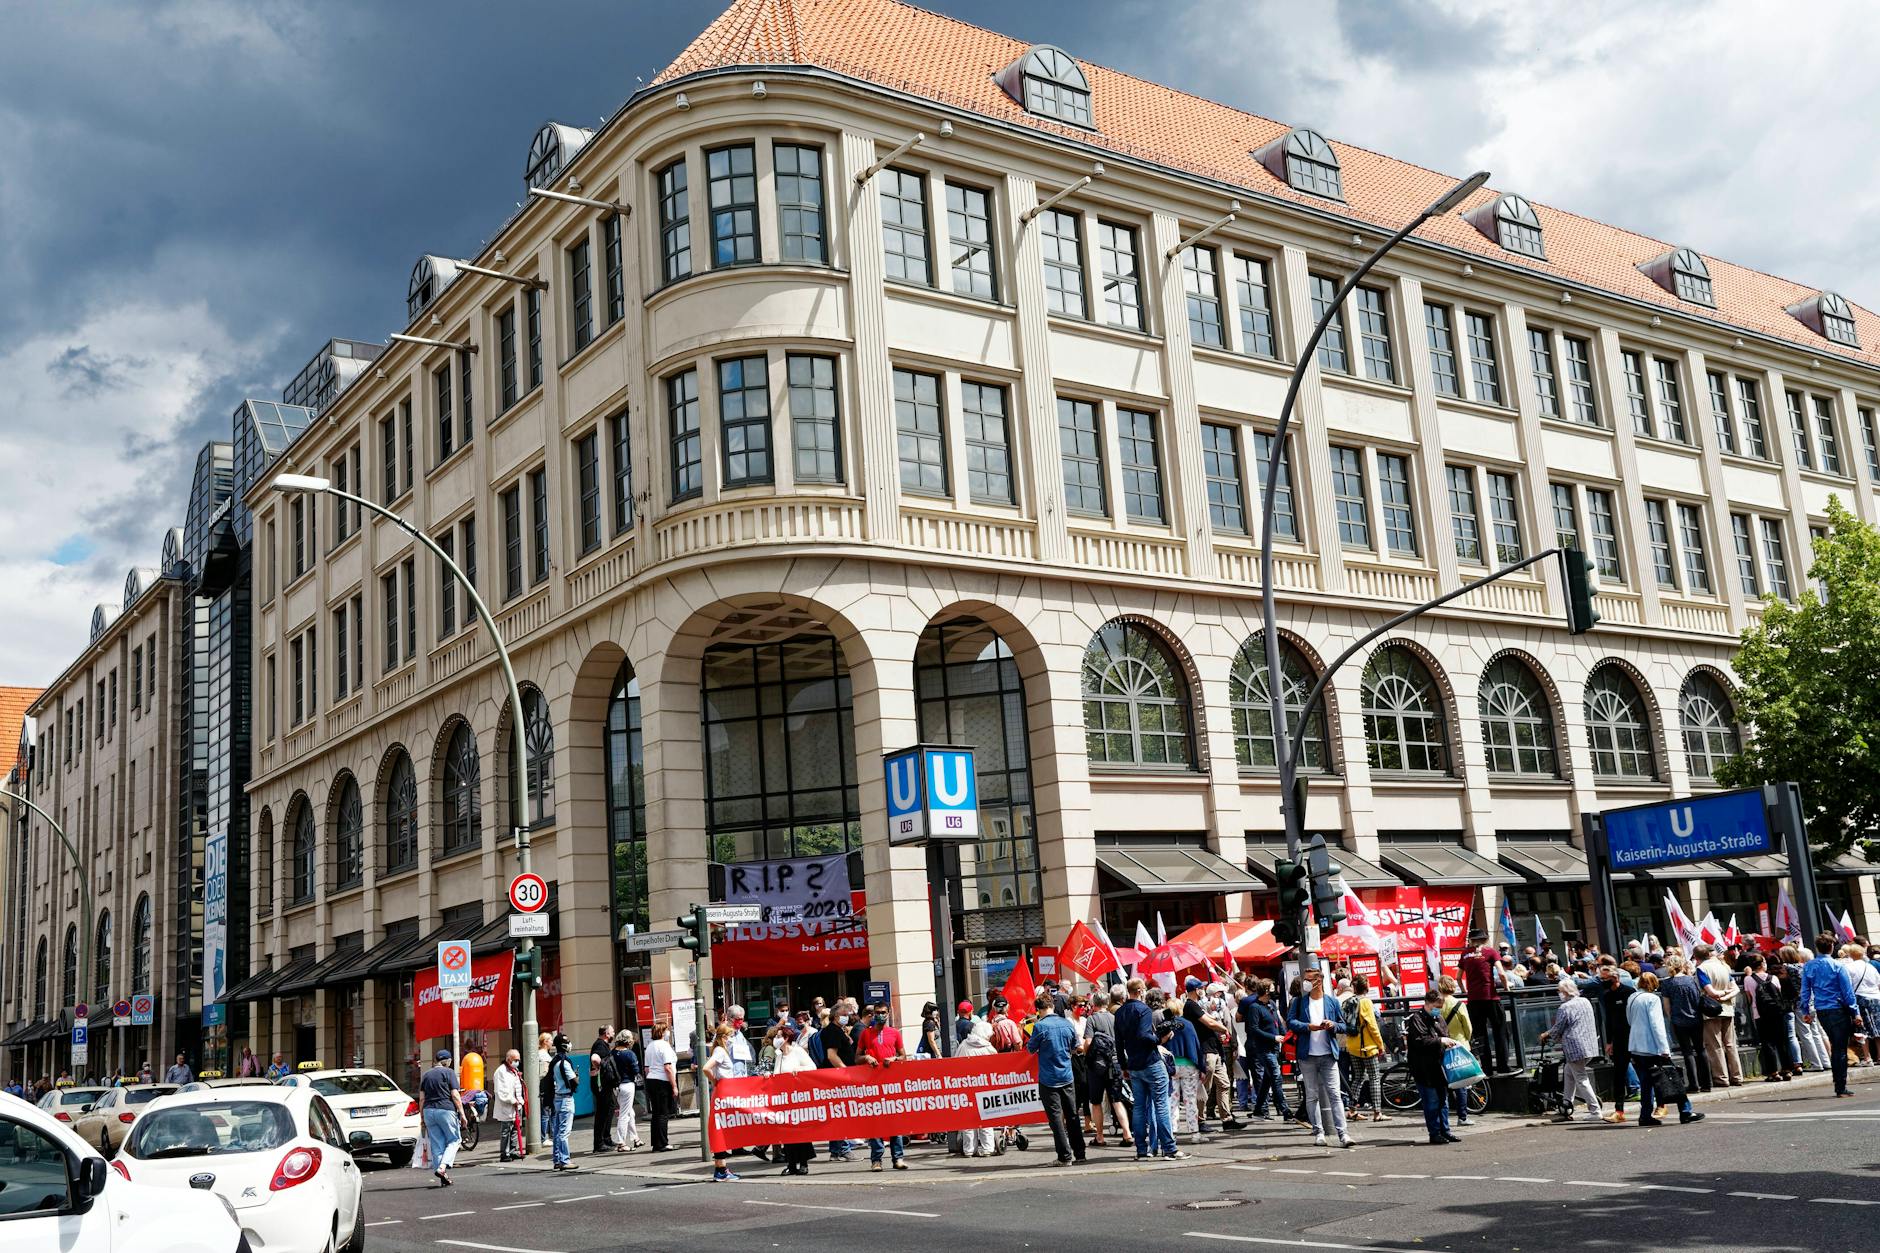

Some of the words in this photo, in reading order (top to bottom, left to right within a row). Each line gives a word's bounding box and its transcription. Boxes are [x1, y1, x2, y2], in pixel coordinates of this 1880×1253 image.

[890, 757, 916, 810] U
[933, 755, 968, 806] U
[901, 821, 912, 832] U6
[947, 817, 961, 827] U6
[1669, 806, 1695, 837] U
[1616, 832, 1762, 863] Kaiserin-Augusta-Straße
[207, 837, 226, 878] DIE
[731, 864, 793, 894] R.I.P.
[206, 877, 225, 901] ODER
[518, 884, 539, 901] 30
[206, 899, 225, 922] KEINE
[706, 908, 759, 919] aiserin-Augusta-Straße
[803, 899, 850, 918] 2020
[769, 914, 803, 925] NEUES
[514, 925, 544, 933] reinhaltung
[632, 935, 665, 946] Tempelhofer
[801, 943, 820, 952] bei
[825, 936, 866, 951] KAR
[971, 950, 987, 959] TOP
[443, 973, 468, 984] TAXI
[457, 995, 495, 1008] ARSTADT
[75, 1028, 84, 1042] P
[714, 1094, 769, 1110] Solidarität
[771, 1092, 789, 1106] mit
[791, 1090, 811, 1104] den
[813, 1084, 879, 1099] Beschäftigten
[882, 1081, 902, 1095] von
[904, 1077, 941, 1093] Galeria
[943, 1073, 989, 1089] Karstadt
[990, 1070, 1035, 1086] Kaufhof.
[982, 1095, 1002, 1109] DIE
[715, 1105, 827, 1130] Nahversorgung
[829, 1102, 847, 1119] ist
[850, 1093, 974, 1118] Daseinsvorsorge.
